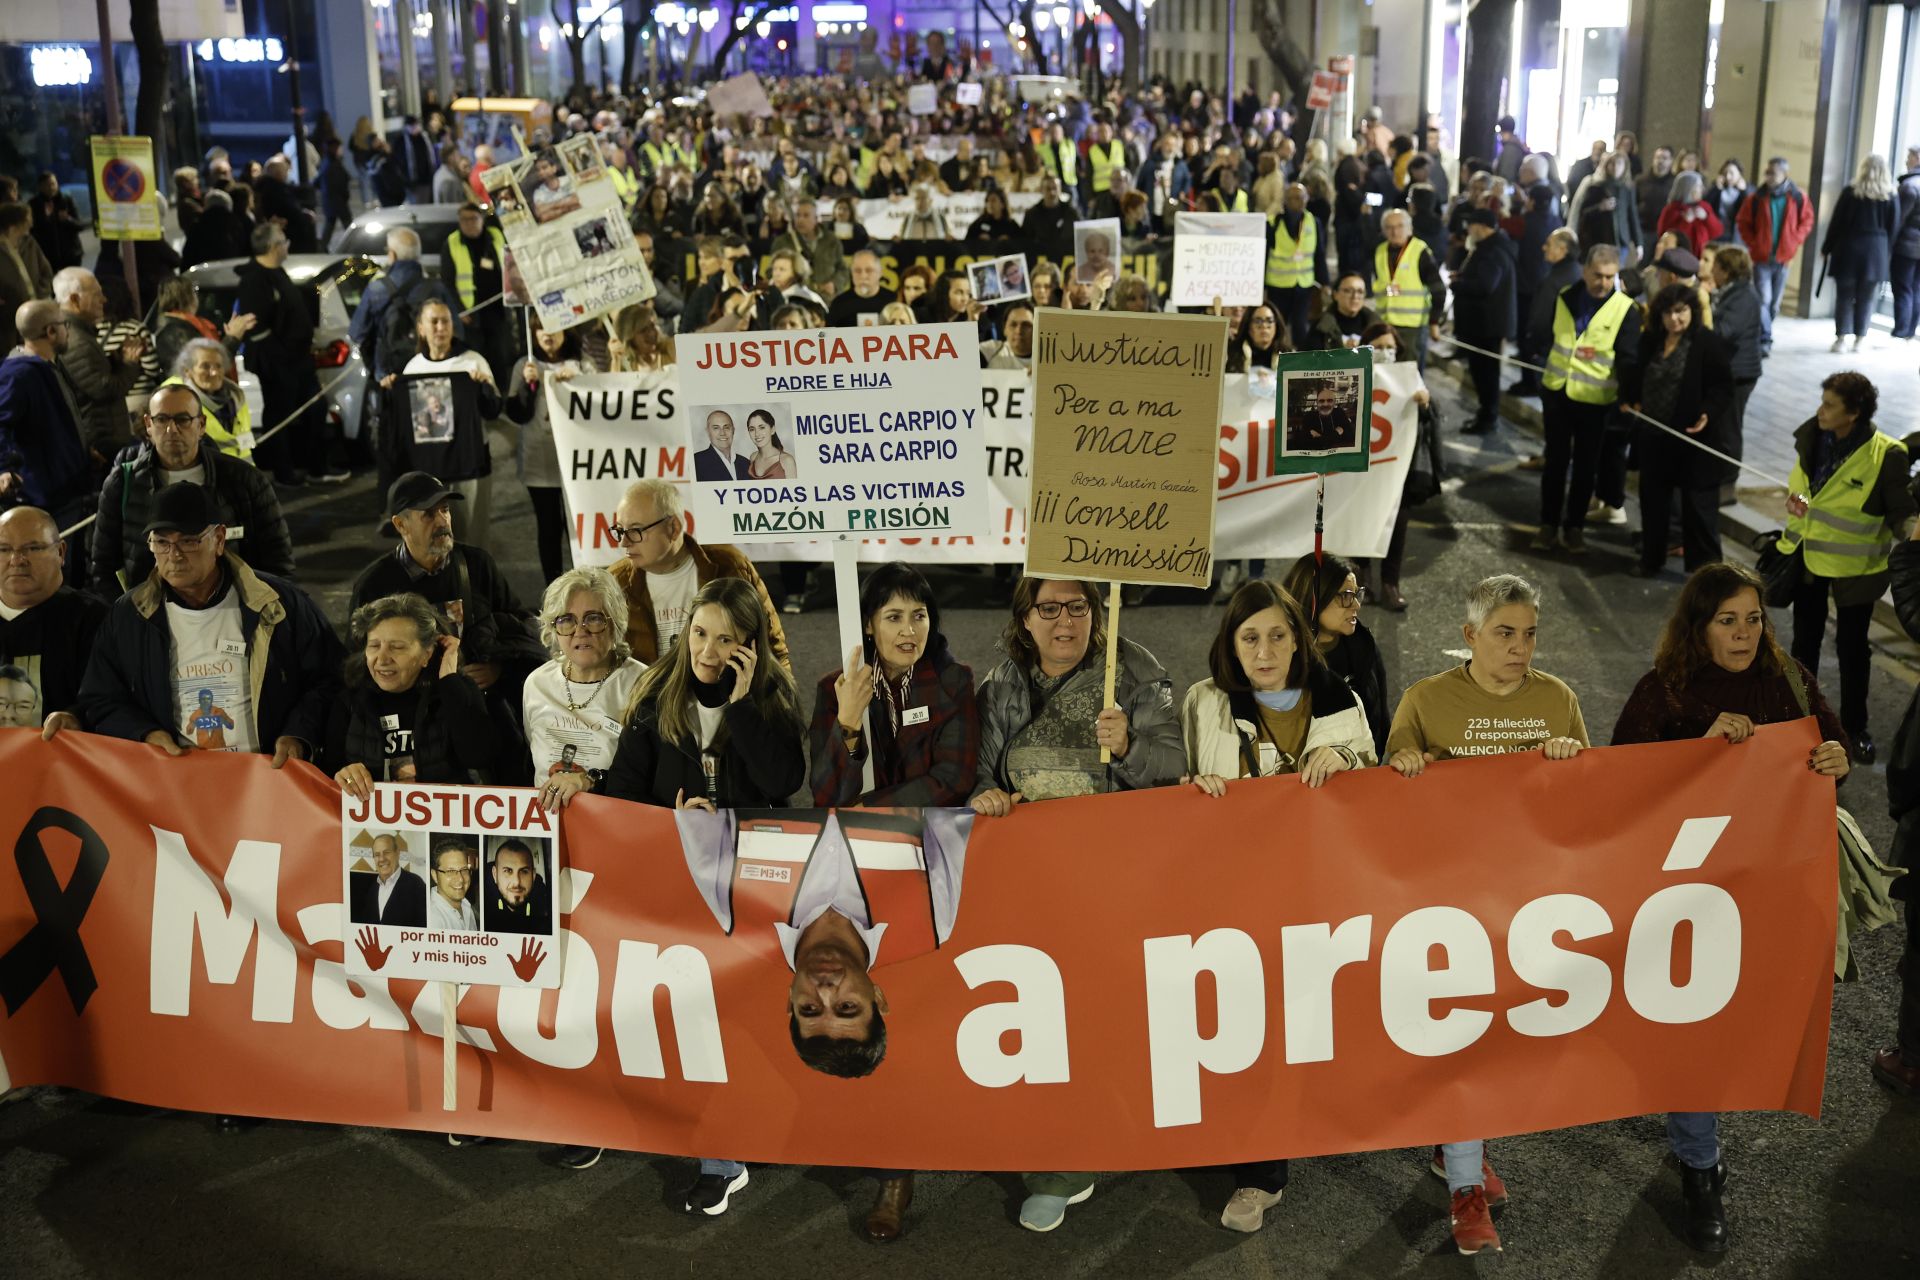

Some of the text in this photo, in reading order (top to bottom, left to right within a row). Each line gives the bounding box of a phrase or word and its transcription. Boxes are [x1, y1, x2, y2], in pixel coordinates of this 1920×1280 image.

[1198, 260, 1256, 275] JUSTICIA
[1185, 280, 1260, 297] ASESINOS
[862, 332, 959, 362] PARA
[766, 372, 892, 391] PADRE E HIJA
[569, 389, 675, 420] NUES
[1054, 384, 1182, 417] Per a ma
[796, 409, 976, 435] MIGUEL CARPIO Y
[819, 439, 958, 464] SARA CARPIO
[1074, 424, 1177, 456] mare
[572, 448, 648, 481] HAN
[1071, 472, 1107, 487] Rosa
[715, 480, 966, 505] Y TODAS LAS VICTIMAS
[732, 506, 826, 533] MAZÓN
[848, 502, 950, 530] PRISIÓN
[658, 607, 689, 621] PRES
[198, 717, 219, 729] 228
[1468, 717, 1546, 728] 229 fallecidos
[384, 730, 415, 754] ST
[1475, 729, 1551, 741] responsables
[1449, 745, 1506, 756] VALENCIA
[349, 790, 551, 831] JUSTICIA
[400, 930, 499, 947] por mi marido
[412, 950, 487, 967] y mis hijos
[954, 944, 1070, 1088] a
[1143, 815, 1741, 1128] presó
